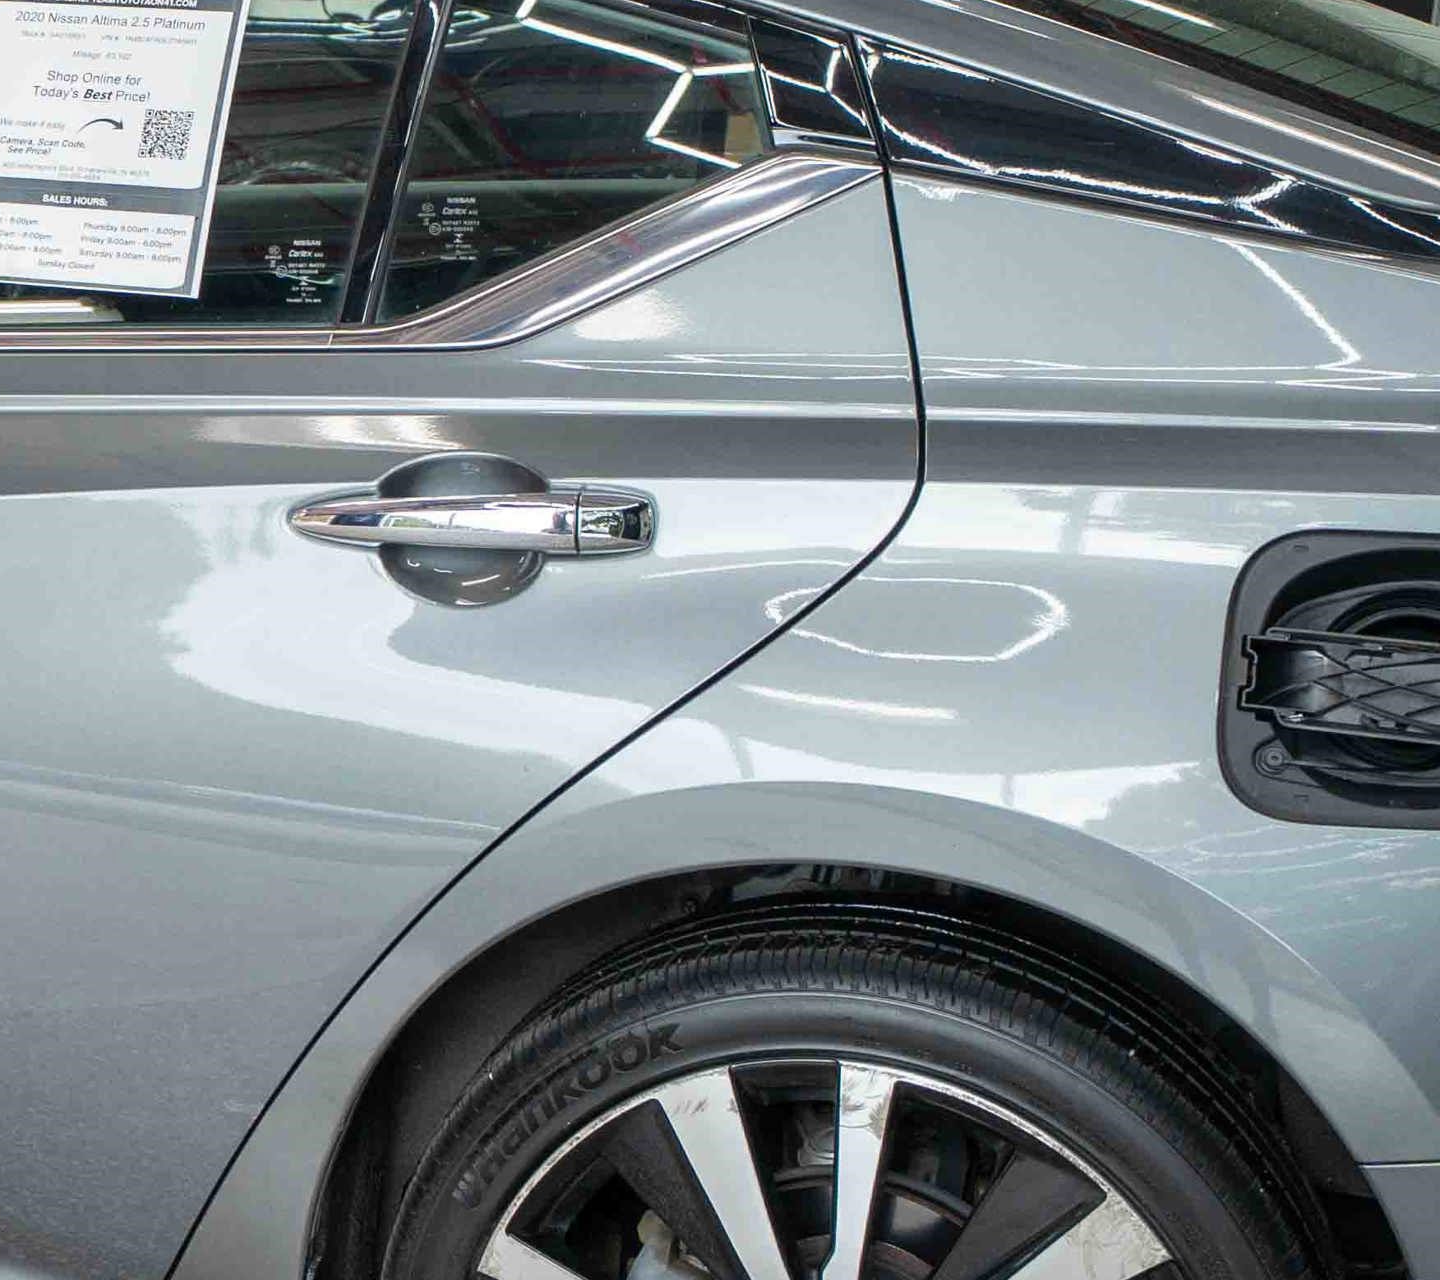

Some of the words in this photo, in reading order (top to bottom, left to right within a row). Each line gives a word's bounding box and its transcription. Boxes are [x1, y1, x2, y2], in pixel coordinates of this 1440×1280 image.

[15, 10, 45, 22] 2020
[48, 13, 88, 24] Nissan
[90, 15, 128, 27] Altima
[131, 17, 150, 28] 2.5
[153, 18, 206, 31] Platinum
[47, 70, 79, 85] Shop
[82, 72, 121, 85] Online
[124, 74, 143, 86] for
[32, 86, 79, 100] Today's
[83, 89, 113, 101] Best
[115, 91, 151, 103] Price!
[7, 145, 24, 153] See
[38, 138, 59, 147] Scan
[42, 193, 71, 205] SALES
[73, 195, 109, 207] HOURS:
[84, 222, 118, 233] Thursday
